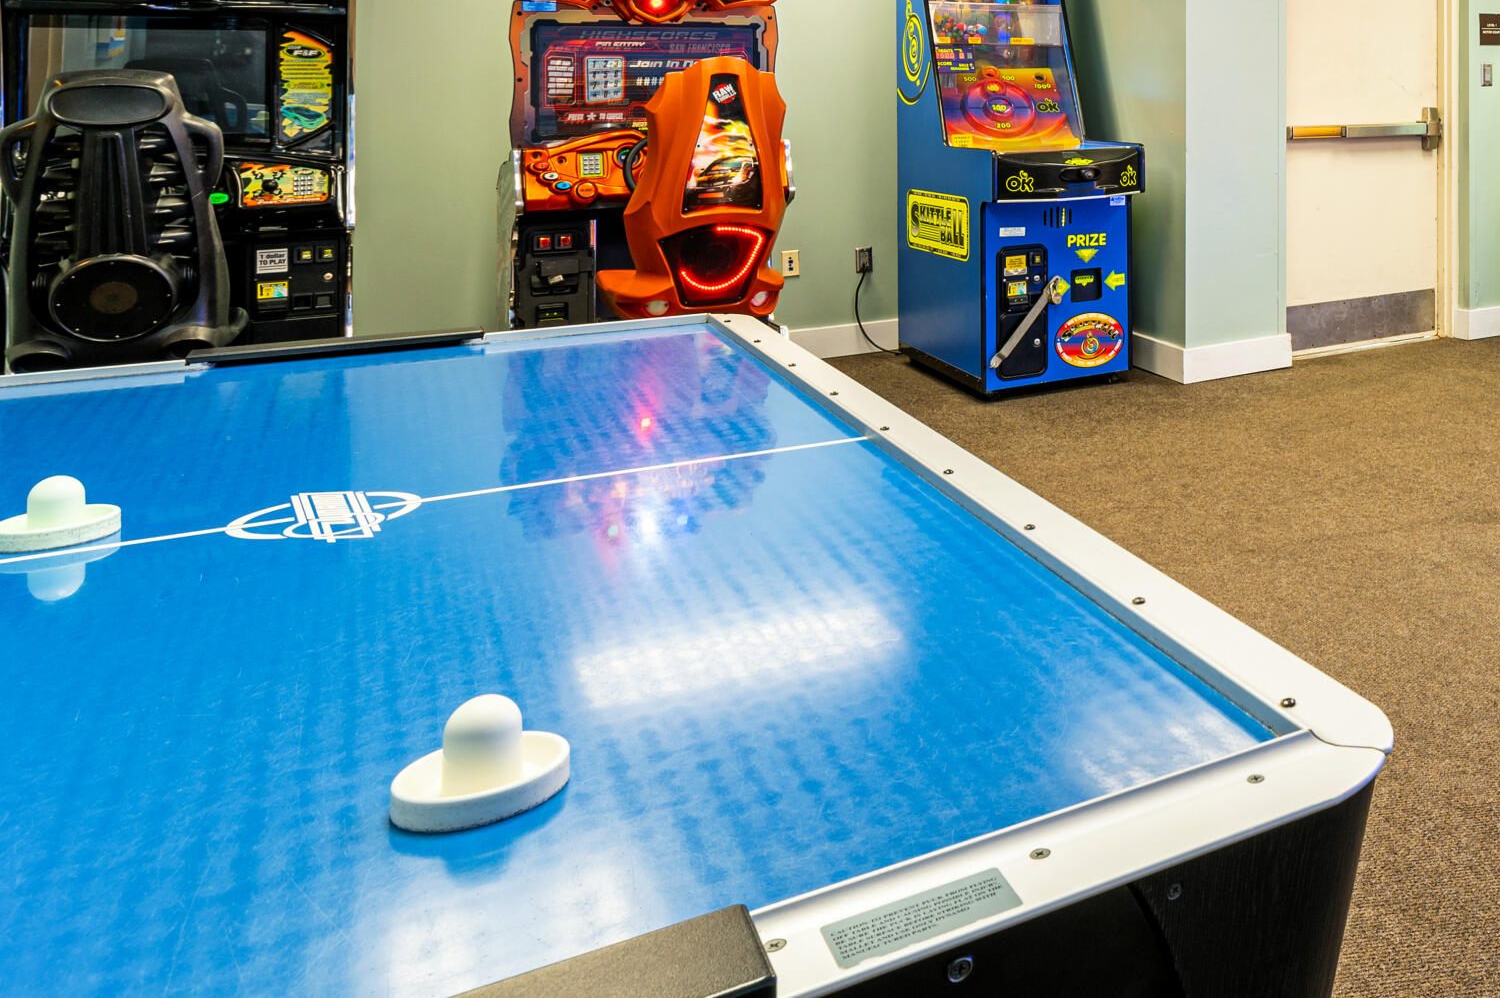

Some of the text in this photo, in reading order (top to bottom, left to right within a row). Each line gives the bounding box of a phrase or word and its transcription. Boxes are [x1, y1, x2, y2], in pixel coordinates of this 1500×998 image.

[911, 201, 952, 238] SKITTLE
[940, 208, 965, 249] BALL
[1067, 233, 1107, 248] PRIZE
